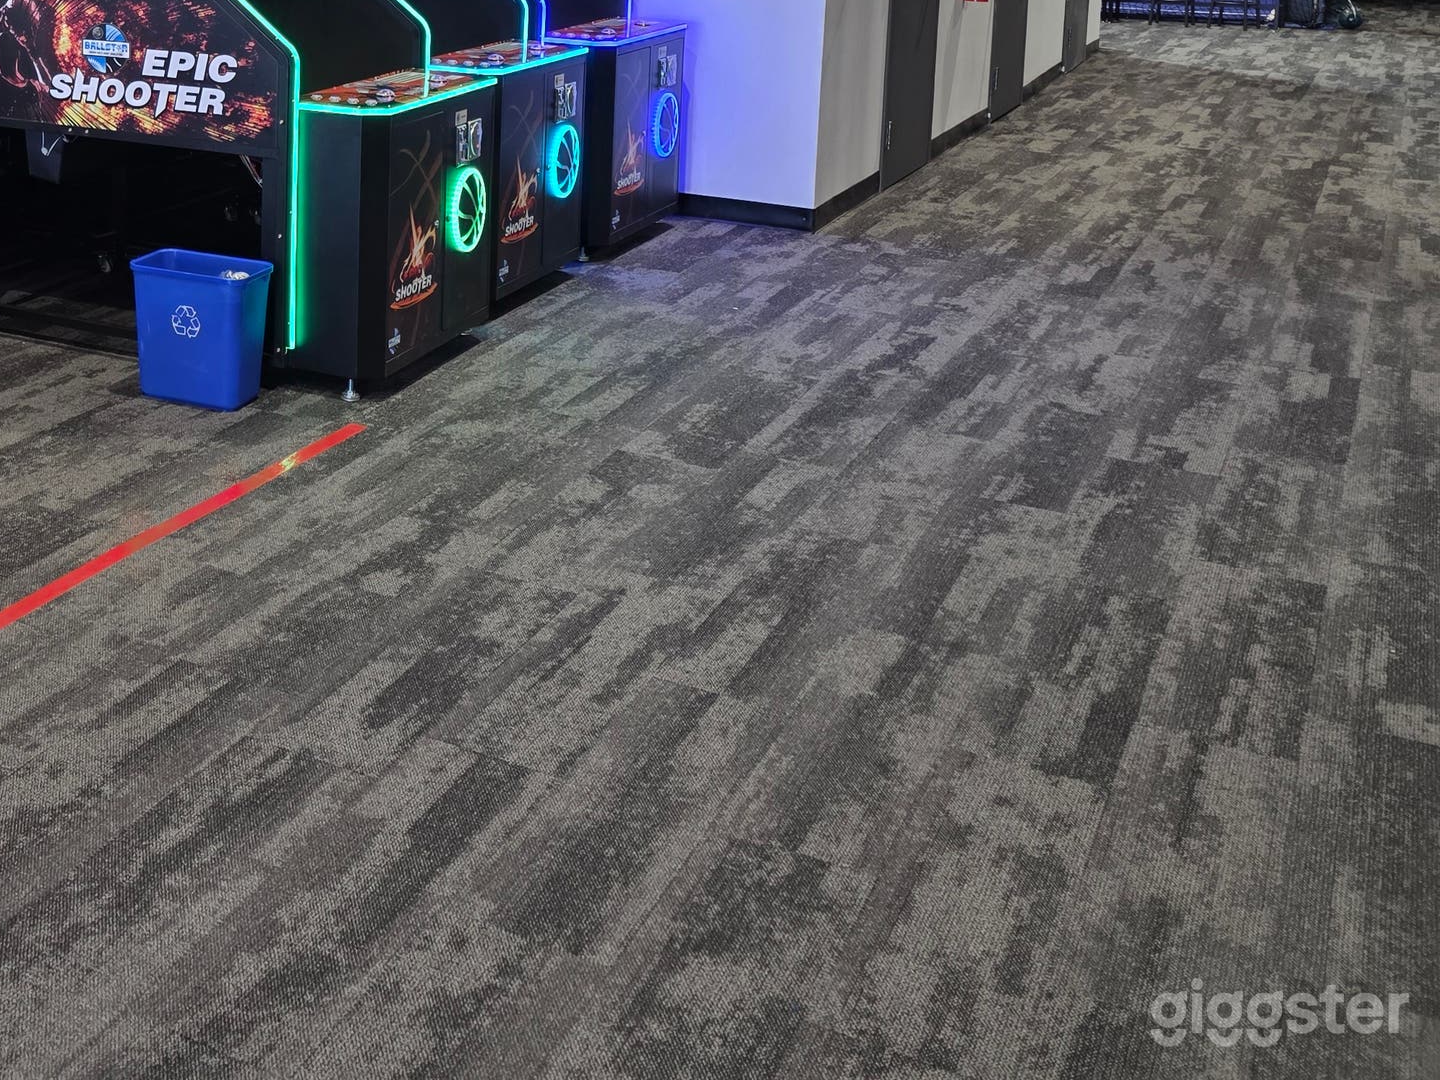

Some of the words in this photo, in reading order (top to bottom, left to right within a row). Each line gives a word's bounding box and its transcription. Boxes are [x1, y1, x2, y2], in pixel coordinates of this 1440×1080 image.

[141, 48, 238, 83] EPIC
[49, 68, 226, 118] SHOOTER
[505, 215, 535, 237] SHOOTER
[395, 274, 433, 302] SHOOTER
